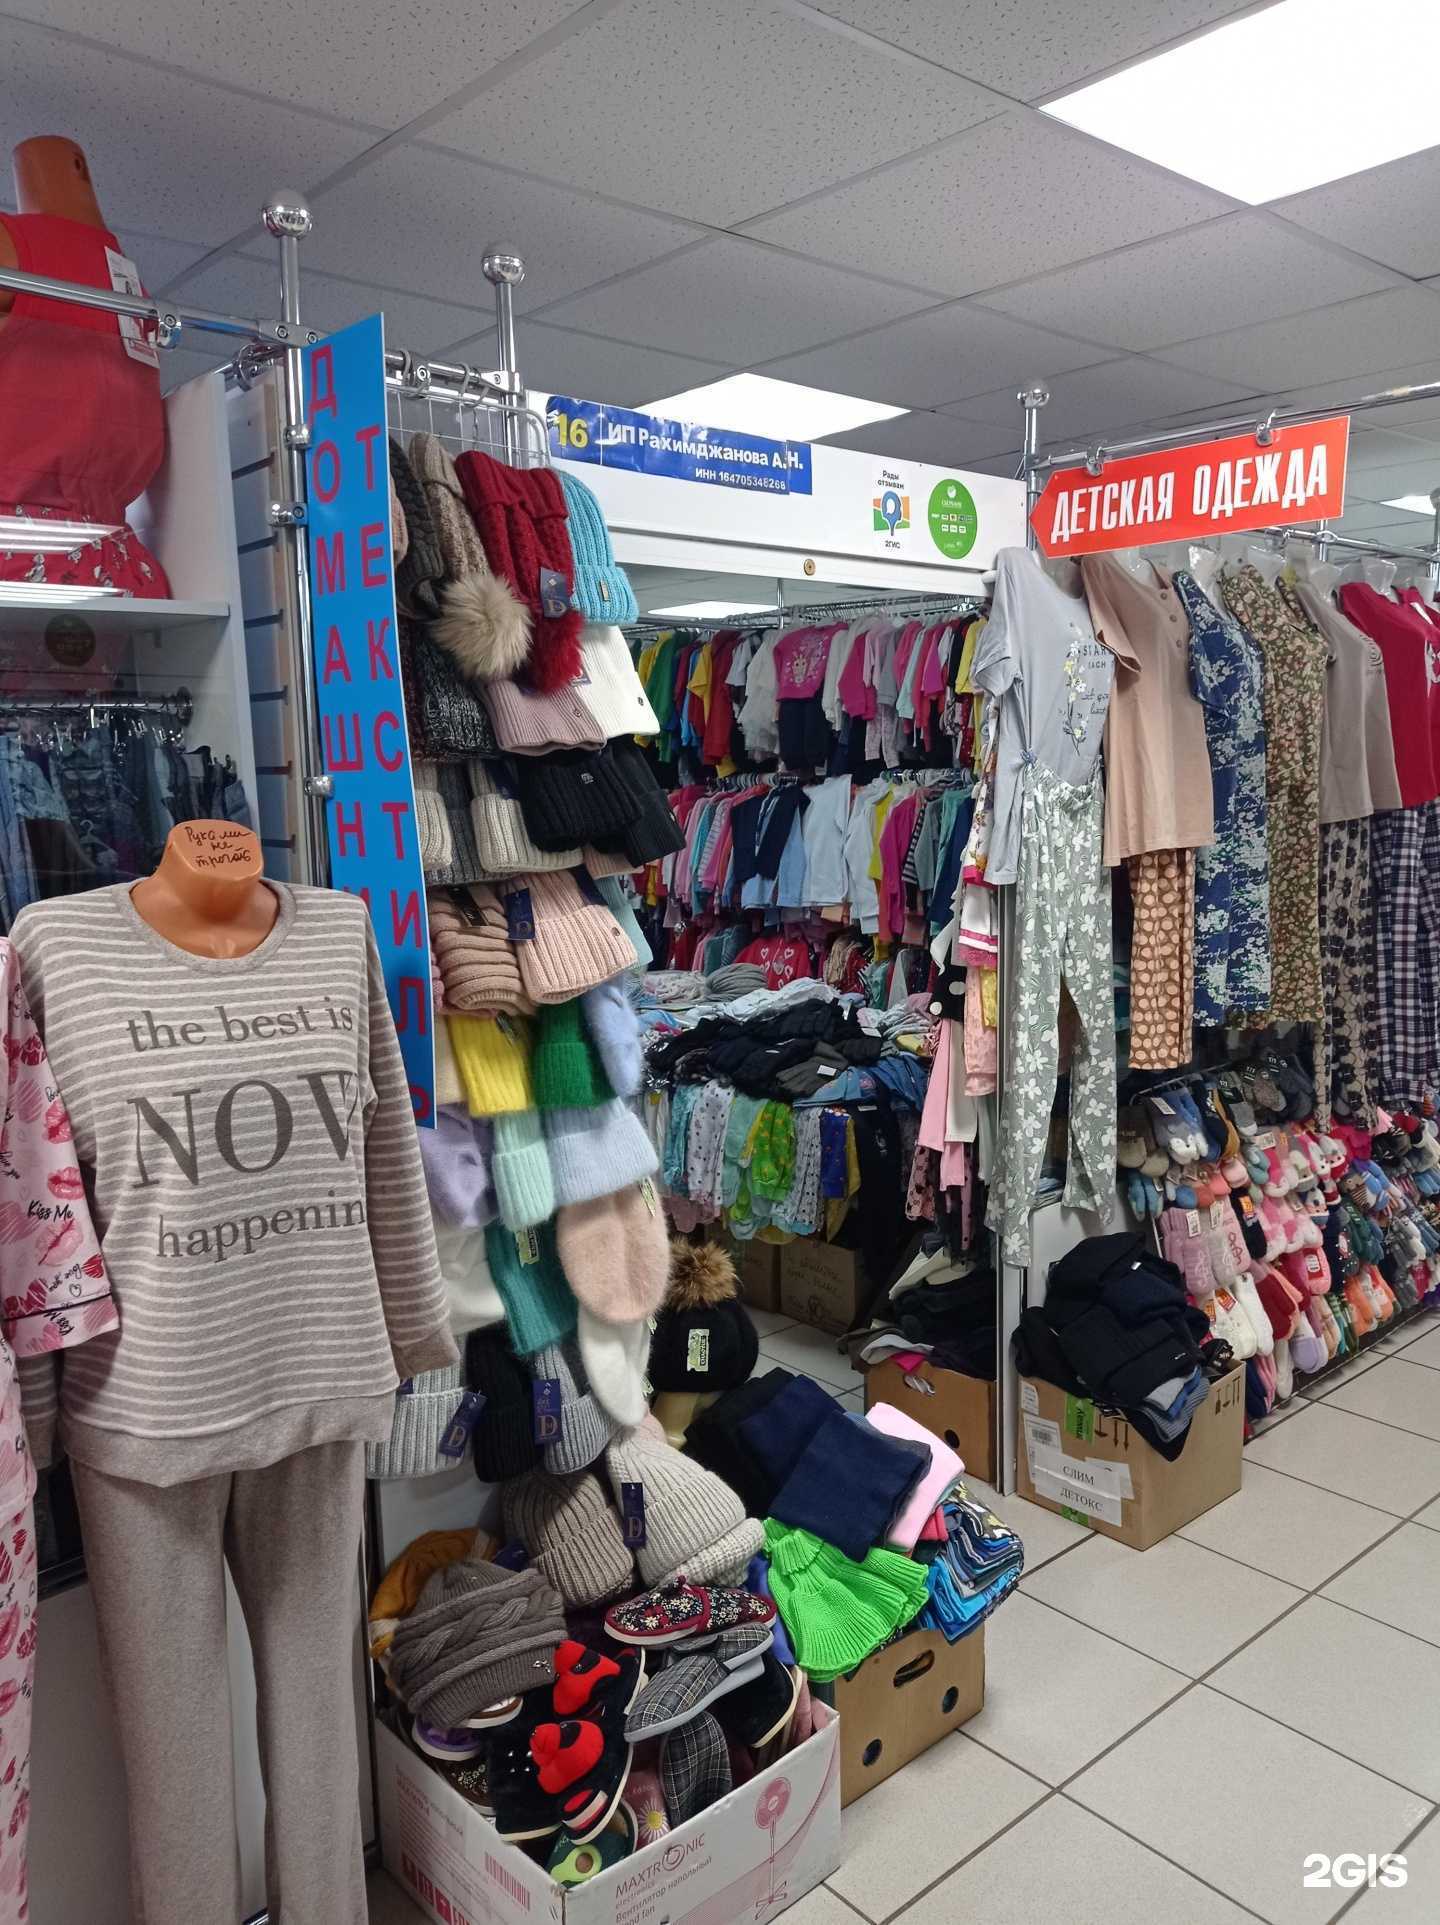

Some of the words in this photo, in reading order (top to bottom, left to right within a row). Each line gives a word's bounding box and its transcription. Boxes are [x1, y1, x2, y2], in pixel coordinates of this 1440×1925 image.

[556, 413, 589, 448] 16
[607, 422, 636, 446] ИП
[639, 427, 769, 466] Рахимджанова
[695, 467, 717, 480] ИНН
[882, 470, 900, 481] Рады
[1049, 471, 1176, 545] ДЕТСКАЯ
[1191, 444, 1328, 520] ОДЕЖДА
[884, 539, 902, 549] 2ГИС
[308, 344, 370, 914] ДОМАШН
[125, 1009, 208, 1053] the
[214, 1004, 317, 1043] best
[325, 995, 354, 1032] is
[27, 1199, 52, 1220] Kiss
[53, 1203, 75, 1222] Me
[156, 1189, 367, 1263] happenin
[1062, 1465, 1095, 1486] СЛИМ
[1060, 1487, 1103, 1512] ДЕТОКС
[615, 1832, 705, 1900] MAXTRONIC
